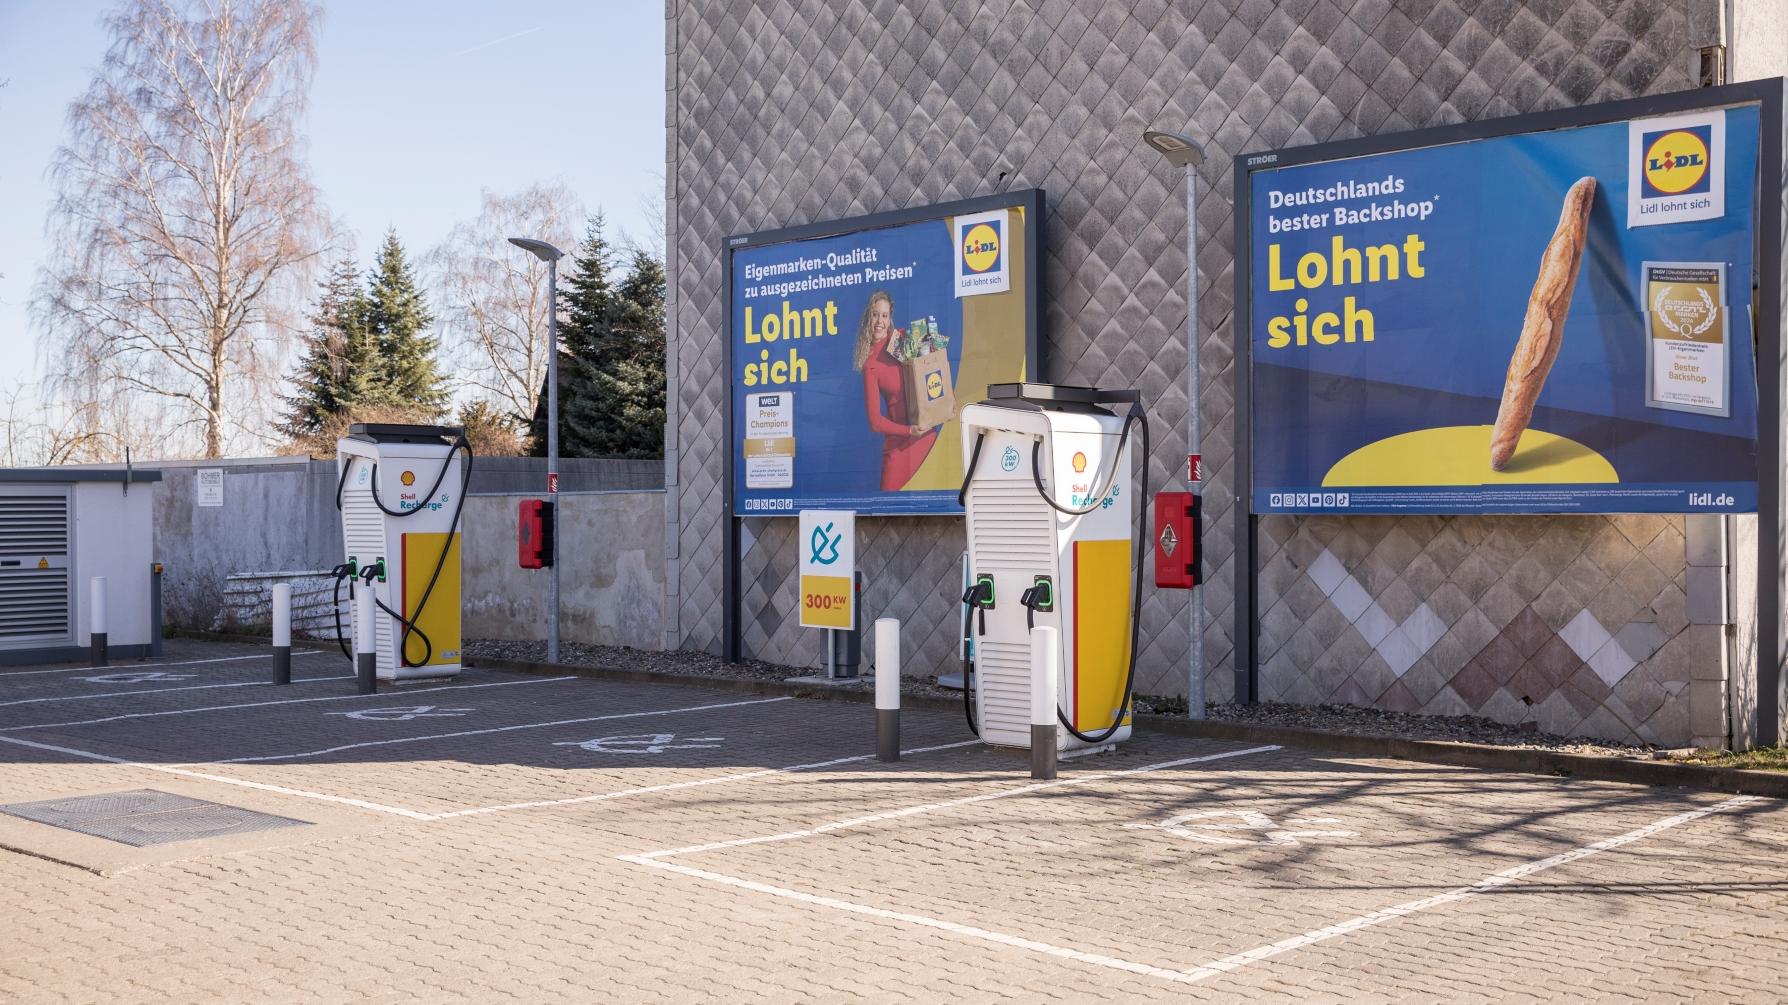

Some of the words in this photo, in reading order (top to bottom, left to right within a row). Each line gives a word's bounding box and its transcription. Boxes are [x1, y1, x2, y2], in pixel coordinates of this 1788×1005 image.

[1269, 175, 1405, 208] Deutschlands
[1641, 204, 1658, 214] Lidl
[1661, 202, 1688, 212] lohnt
[1690, 198, 1711, 210] sich
[1269, 213, 1329, 233] bester
[745, 248, 877, 281] Eigenmarken-Qualität
[1269, 234, 1425, 291] Lohnt
[745, 287, 758, 298] zu
[761, 273, 862, 297] ausgezeichneten
[961, 280, 972, 288] Lidl
[990, 276, 1002, 284] sich
[745, 301, 838, 344] Lohnt
[1267, 296, 1375, 348] sich
[743, 348, 808, 386] sich
[1674, 362, 1700, 372] Bester
[1669, 371, 1707, 384] Backshop
[760, 409, 779, 418] Preis-
[751, 420, 788, 429] Champions
[1072, 484, 1088, 493] Shell
[1689, 492, 1735, 506] lidl.de
[806, 594, 831, 609] 300
